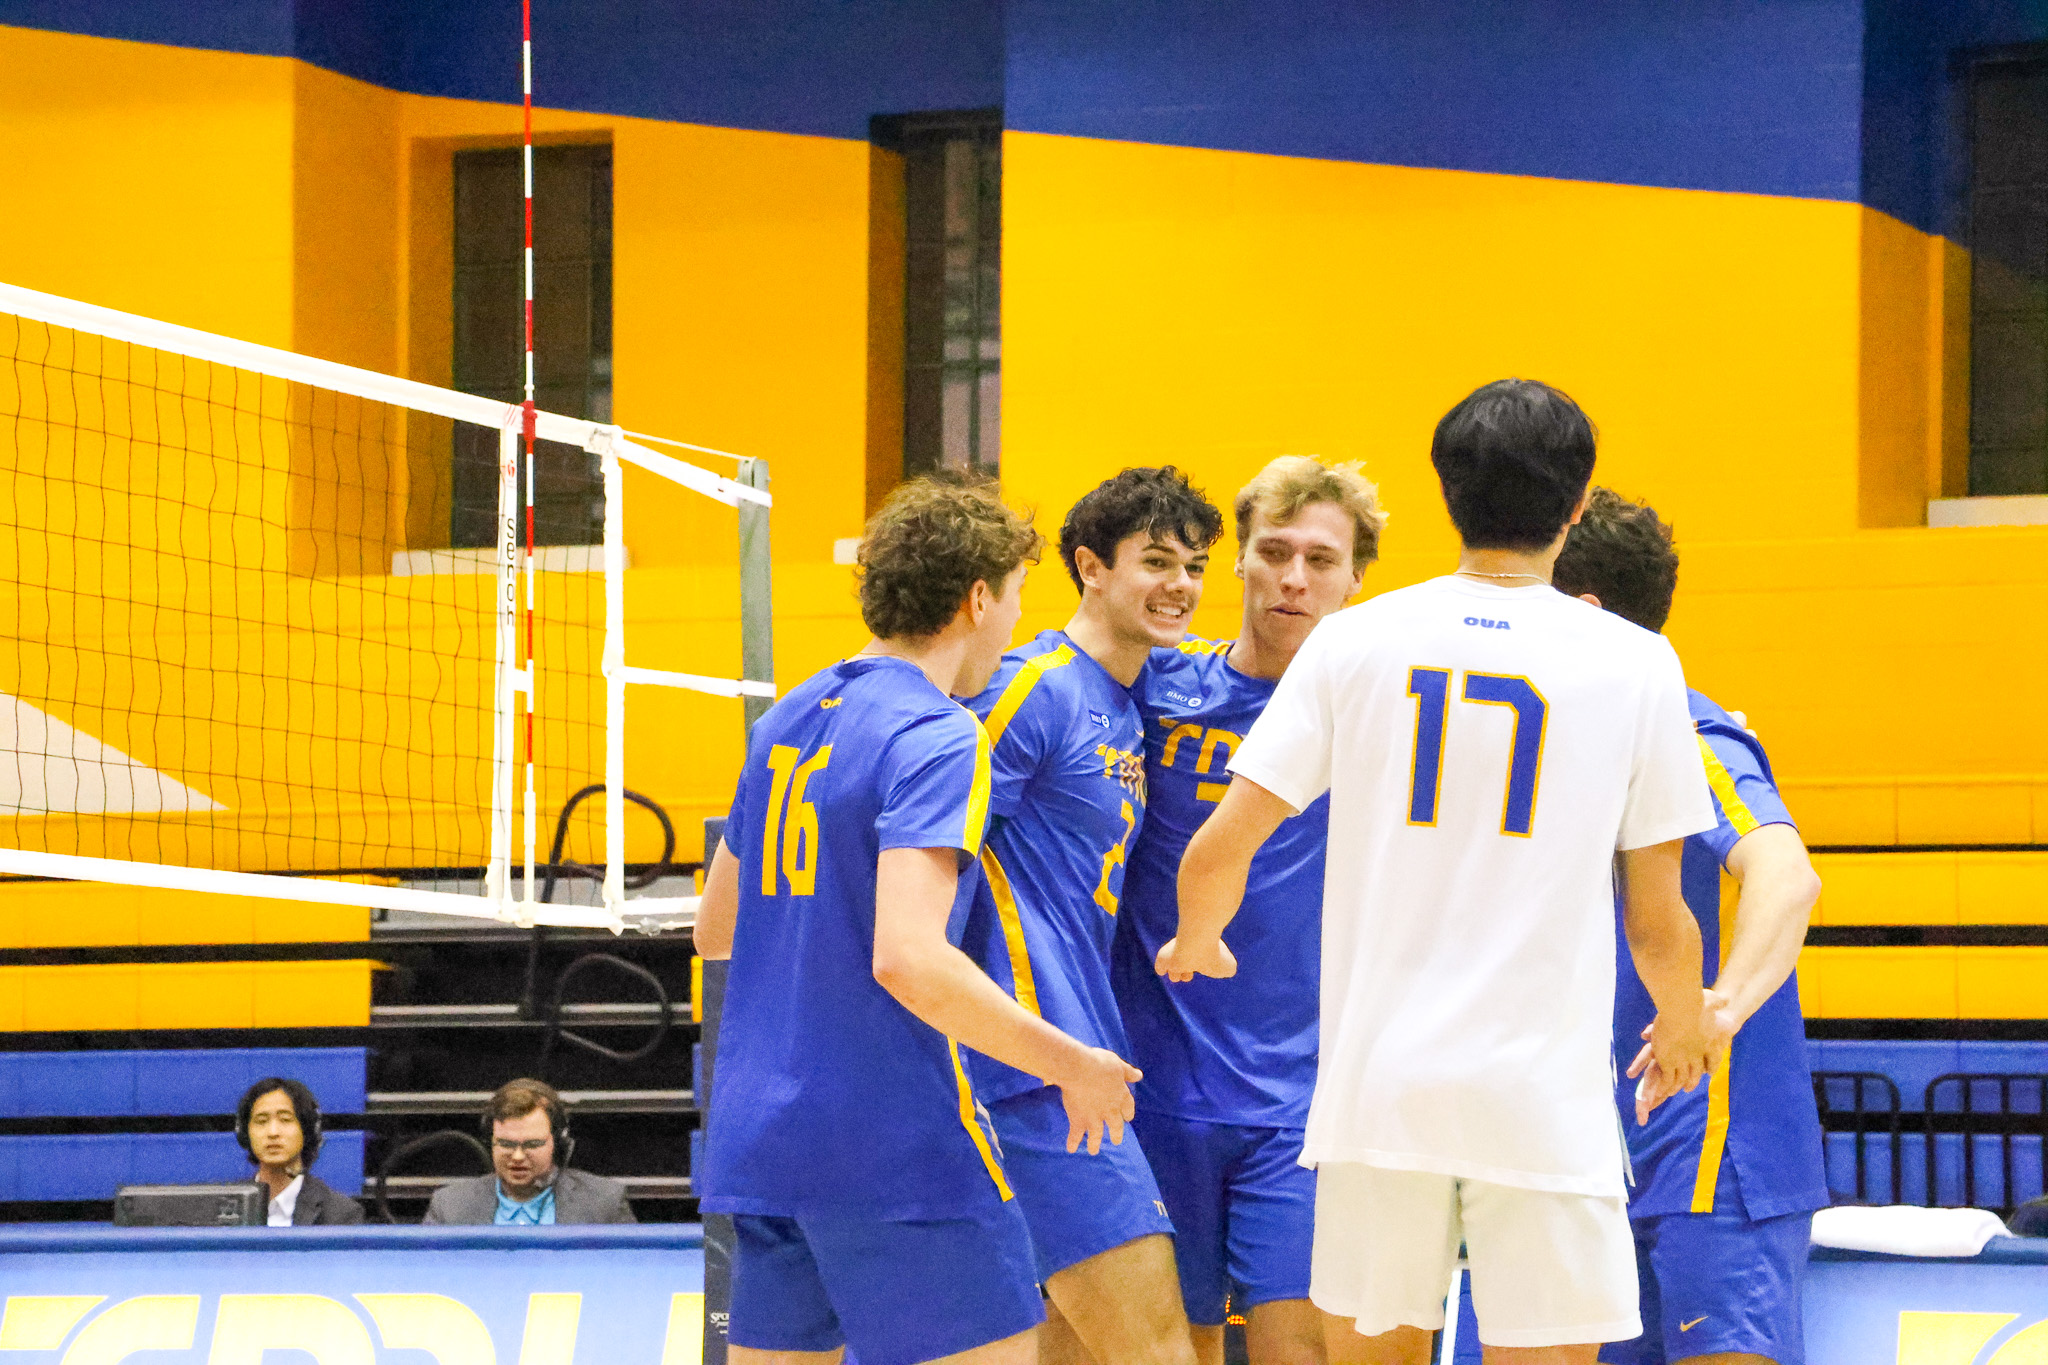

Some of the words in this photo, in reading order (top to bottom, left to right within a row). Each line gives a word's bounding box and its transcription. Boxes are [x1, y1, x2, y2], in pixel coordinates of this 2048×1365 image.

[506, 518, 516, 627] Senoh
[1463, 616, 1512, 631] OUA
[1166, 690, 1188, 702] BMO
[1406, 665, 1550, 839] 17
[761, 743, 834, 896] 16
